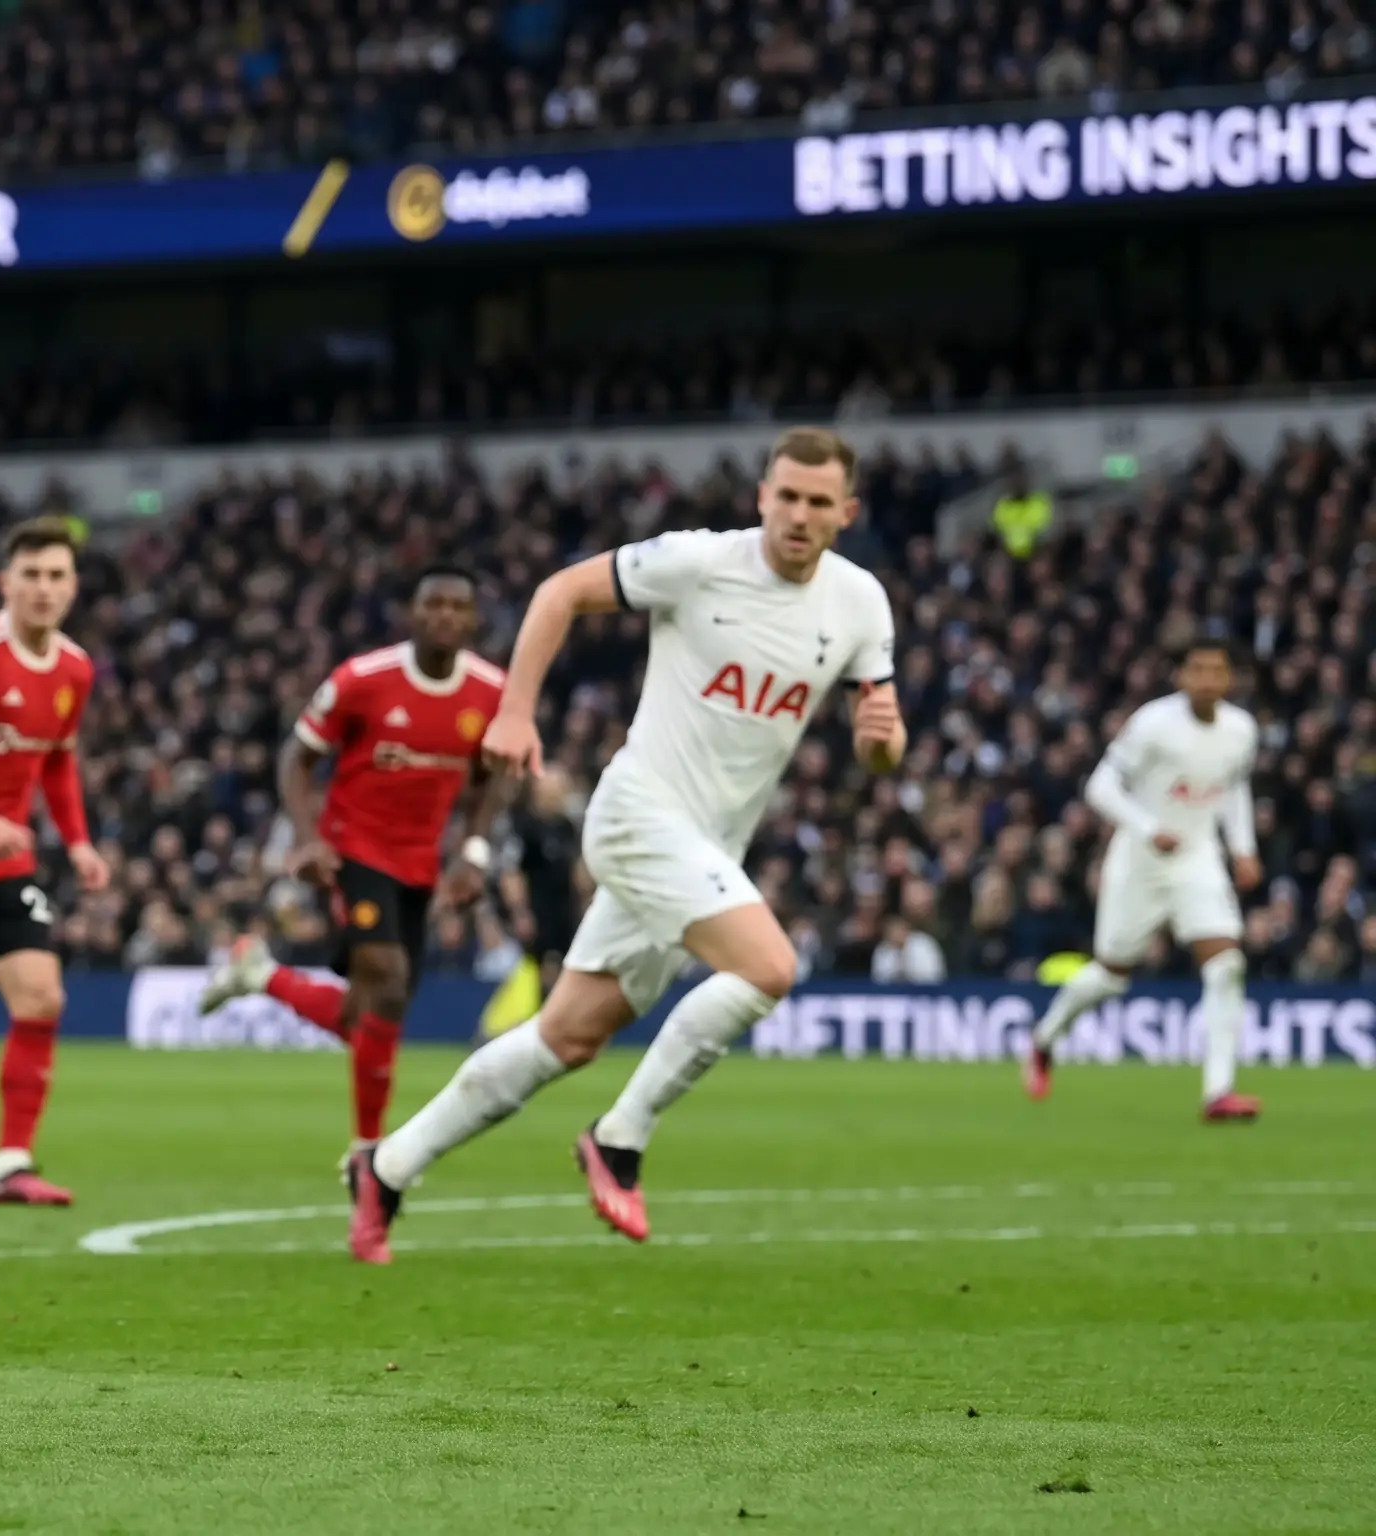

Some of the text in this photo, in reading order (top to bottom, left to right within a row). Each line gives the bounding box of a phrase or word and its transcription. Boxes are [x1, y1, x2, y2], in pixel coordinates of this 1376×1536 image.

[794, 97, 1376, 215] BETTING INSIGHTS
[701, 662, 810, 720] AIA
[20, 885, 54, 925] 2
[1052, 997, 1376, 1068] NSIHTS
